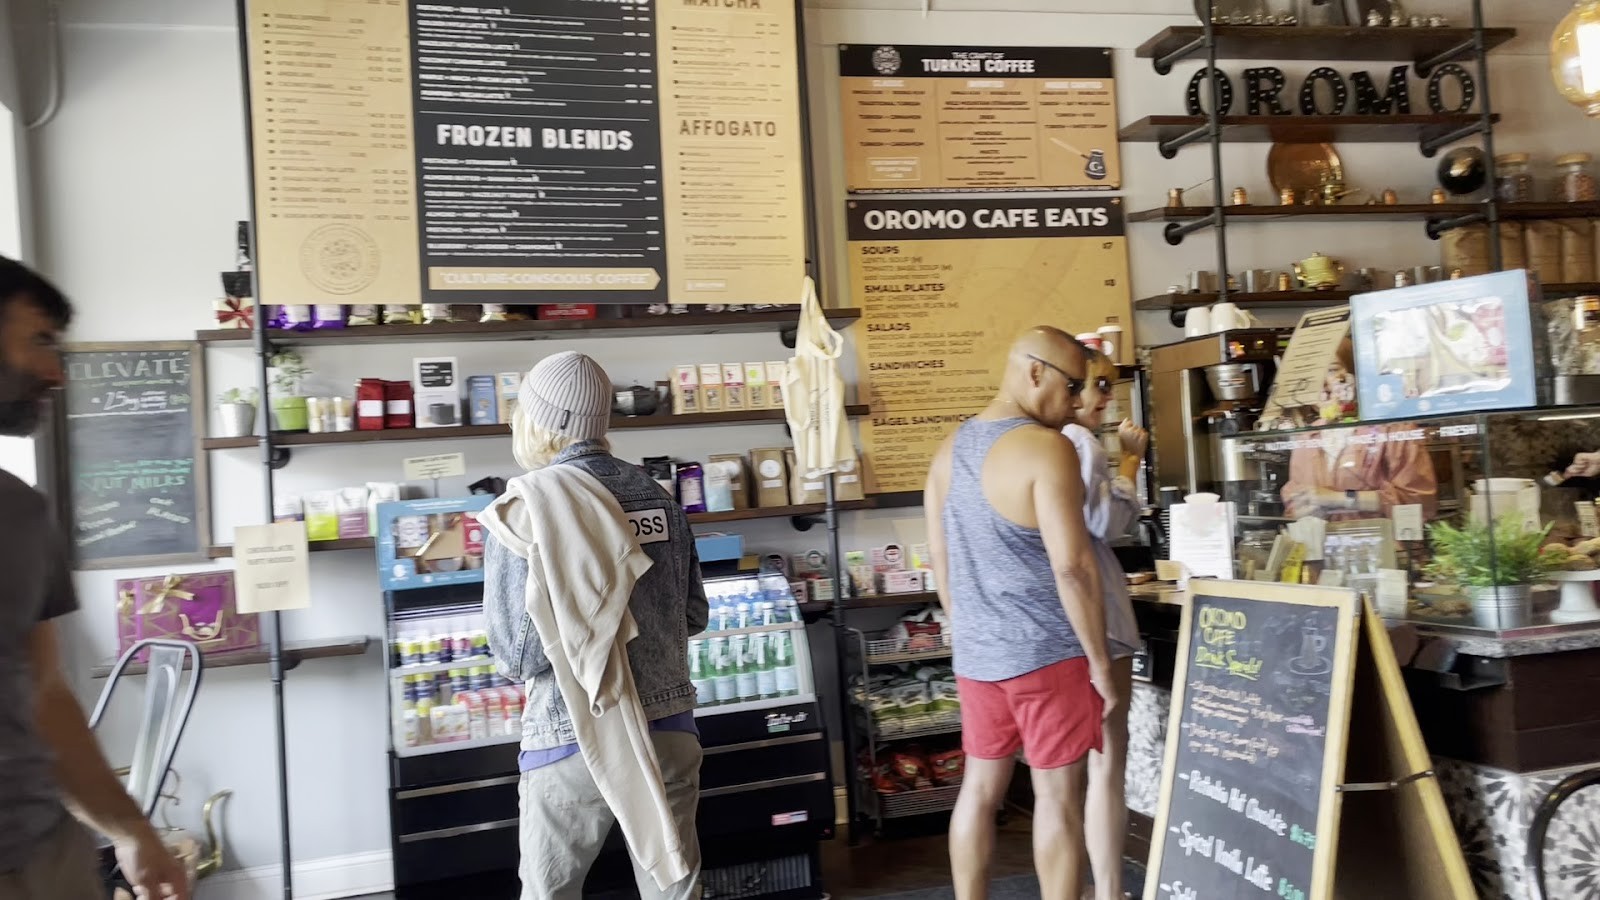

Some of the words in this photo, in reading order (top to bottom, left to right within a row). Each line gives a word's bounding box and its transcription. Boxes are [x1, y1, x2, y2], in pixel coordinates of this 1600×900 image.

[921, 58, 980, 73] TURKISH
[984, 59, 1035, 73] COFFEE
[1186, 63, 1475, 115] OROMO
[679, 120, 777, 137] AFFOGATO
[437, 124, 532, 148] FROZEN
[541, 128, 634, 151] BLENDS
[863, 209, 967, 230] OROMO
[972, 208, 1039, 229] CAFE
[1044, 207, 1109, 228] EATS
[861, 246, 900, 255] SOUPS
[864, 285, 901, 293] SMALL
[904, 283, 945, 292] PLATES
[867, 322, 911, 332] SALADS
[869, 359, 945, 371] SANDWICHES
[872, 417, 909, 427] BAGEL
[912, 413, 979, 424] SANDWICH
